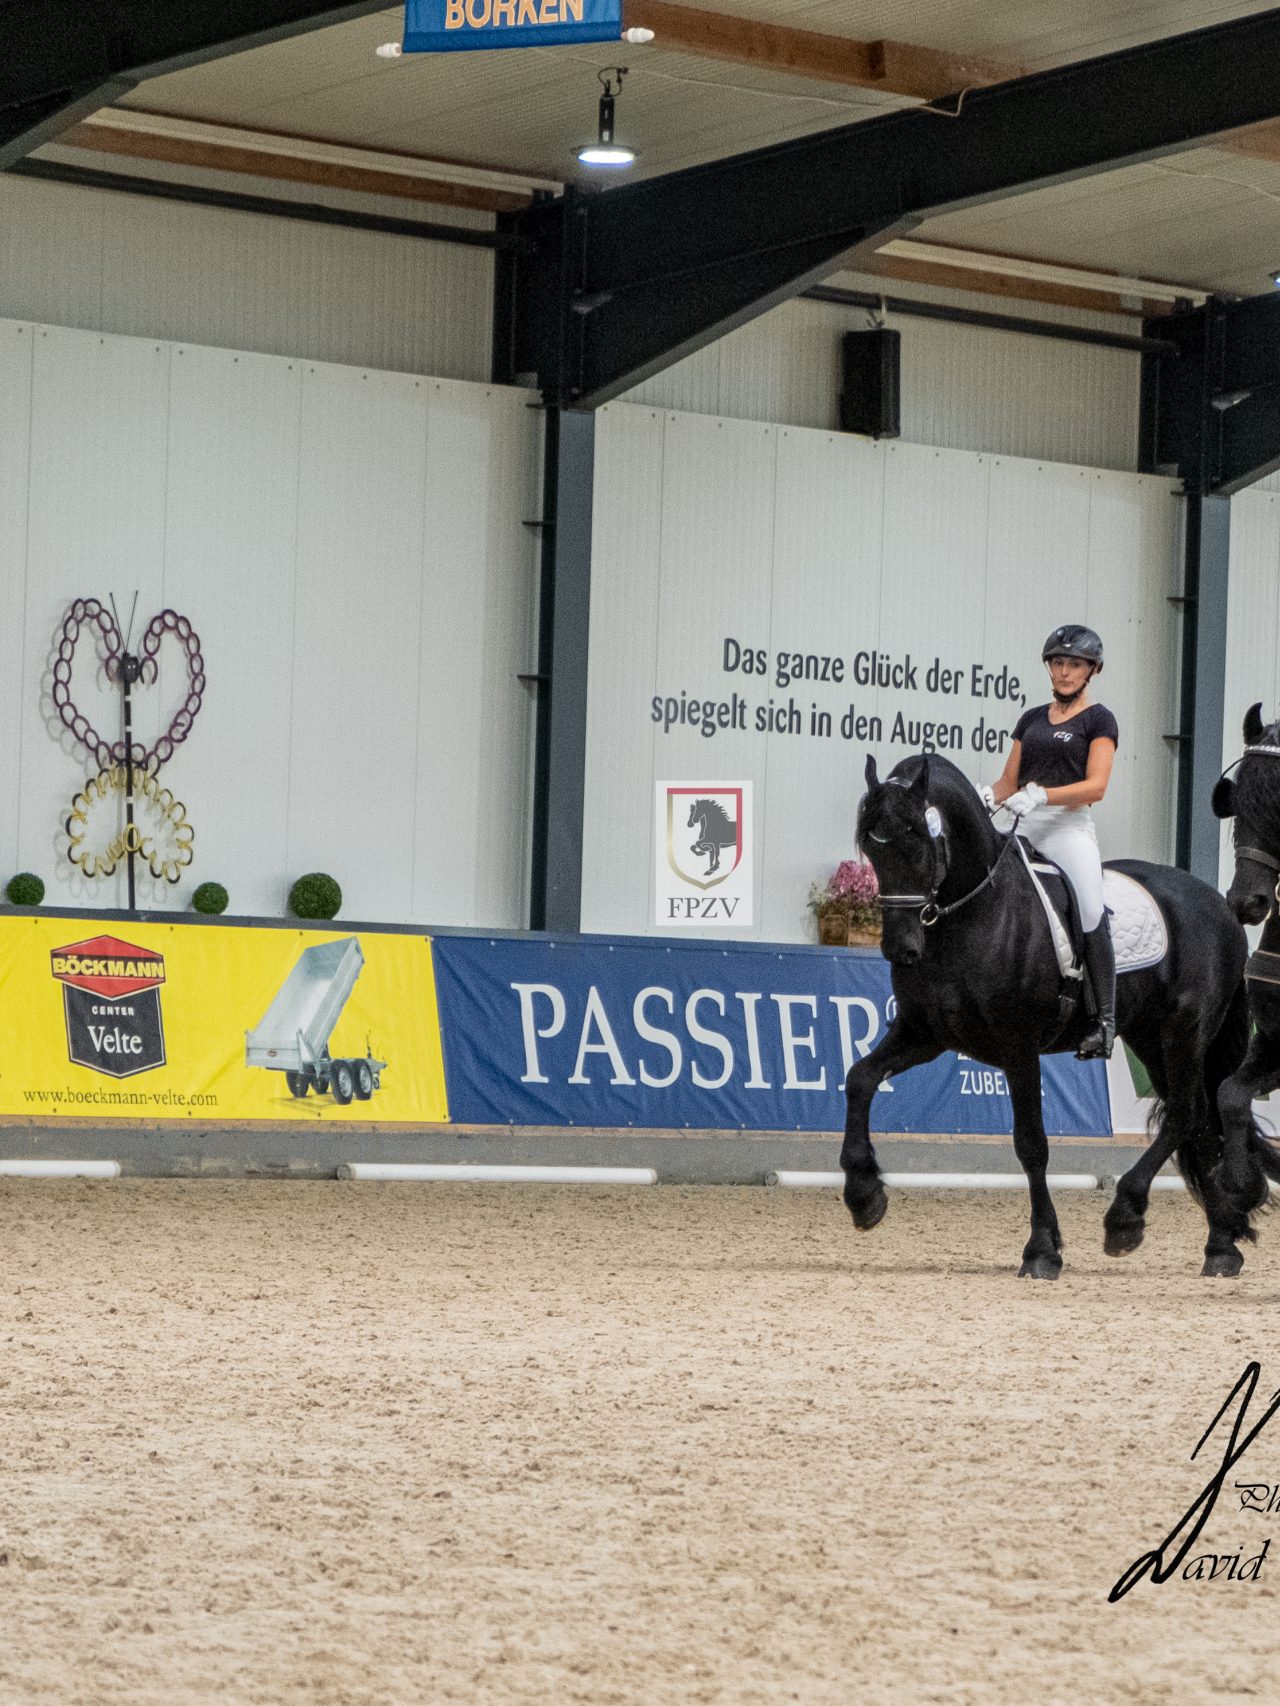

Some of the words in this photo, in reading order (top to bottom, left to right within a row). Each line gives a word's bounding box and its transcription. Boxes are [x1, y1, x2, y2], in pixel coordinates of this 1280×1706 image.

[445, 0, 583, 29] BORKEN
[722, 637, 767, 676] Das
[775, 651, 844, 688] ganze
[853, 650, 918, 690] Glück
[925, 657, 965, 695] der
[970, 664, 1026, 708] Erde,
[650, 690, 747, 738] spiegelt
[755, 698, 801, 735] sich
[810, 703, 832, 737] in
[840, 704, 882, 742] den
[890, 711, 963, 754] Augen
[971, 717, 1008, 753] der
[668, 897, 740, 919] FPZV
[52, 956, 164, 978] BÖCKMANN
[91, 1005, 135, 1016] CENTER
[87, 1025, 143, 1054] Velte
[23, 1086, 218, 1107] www.boeckmann-velte.com
